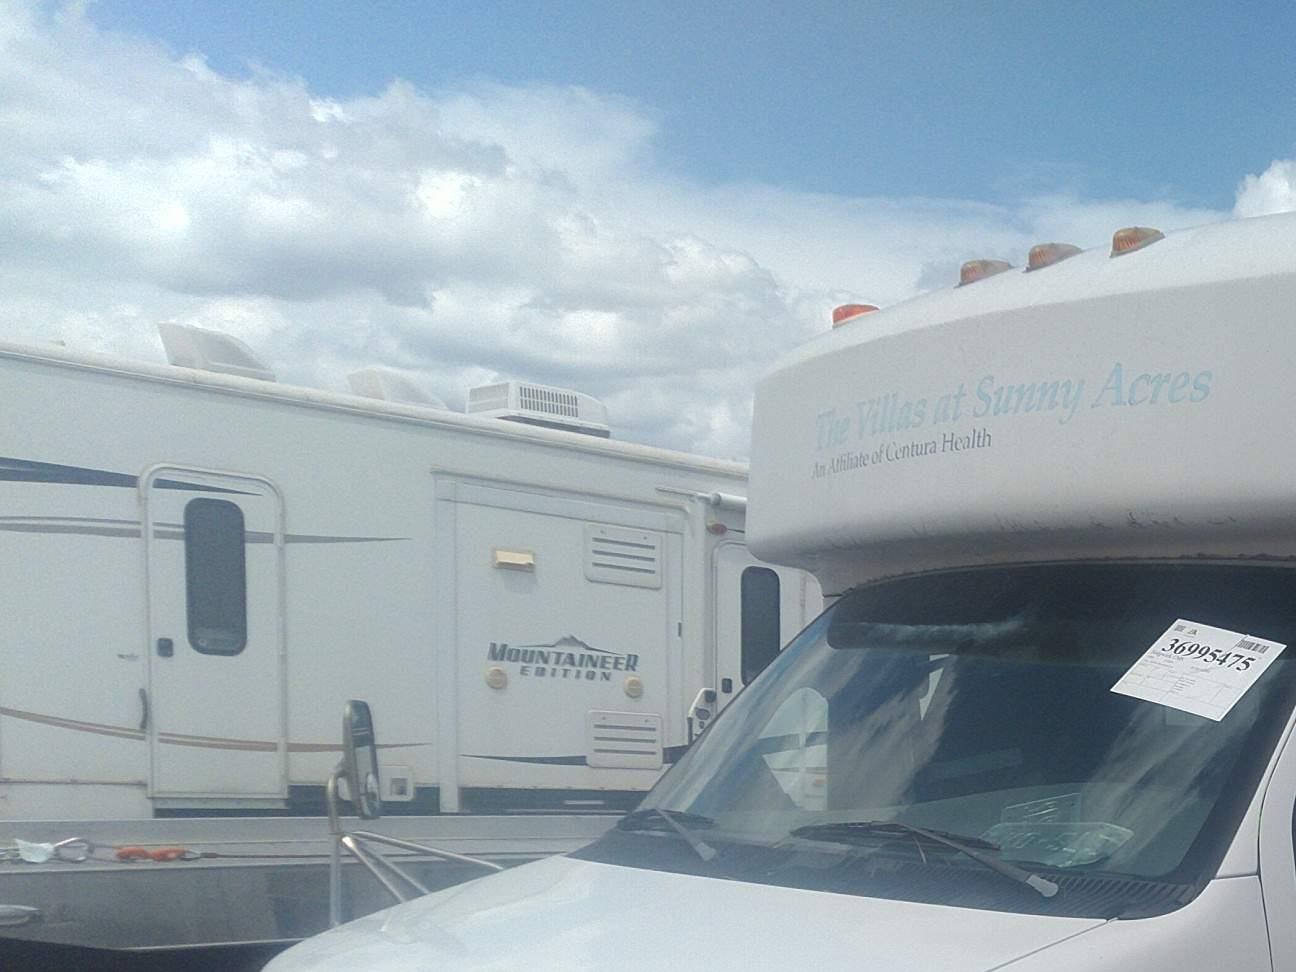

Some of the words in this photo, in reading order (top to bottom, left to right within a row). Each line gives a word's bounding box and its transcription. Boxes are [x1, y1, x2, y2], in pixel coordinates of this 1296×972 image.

[856, 391, 927, 439] Villas
[934, 383, 967, 425] at
[973, 375, 1086, 425] Sunny
[1091, 362, 1213, 408] Acres
[812, 461, 827, 480] An
[829, 450, 870, 476] Affiliate
[870, 443, 885, 466] of
[885, 439, 938, 463] Centura
[941, 426, 993, 453] Health
[488, 642, 639, 671] MOUNTAINEER
[1161, 638, 1257, 672] 36995475
[520, 666, 612, 681] EDITION
